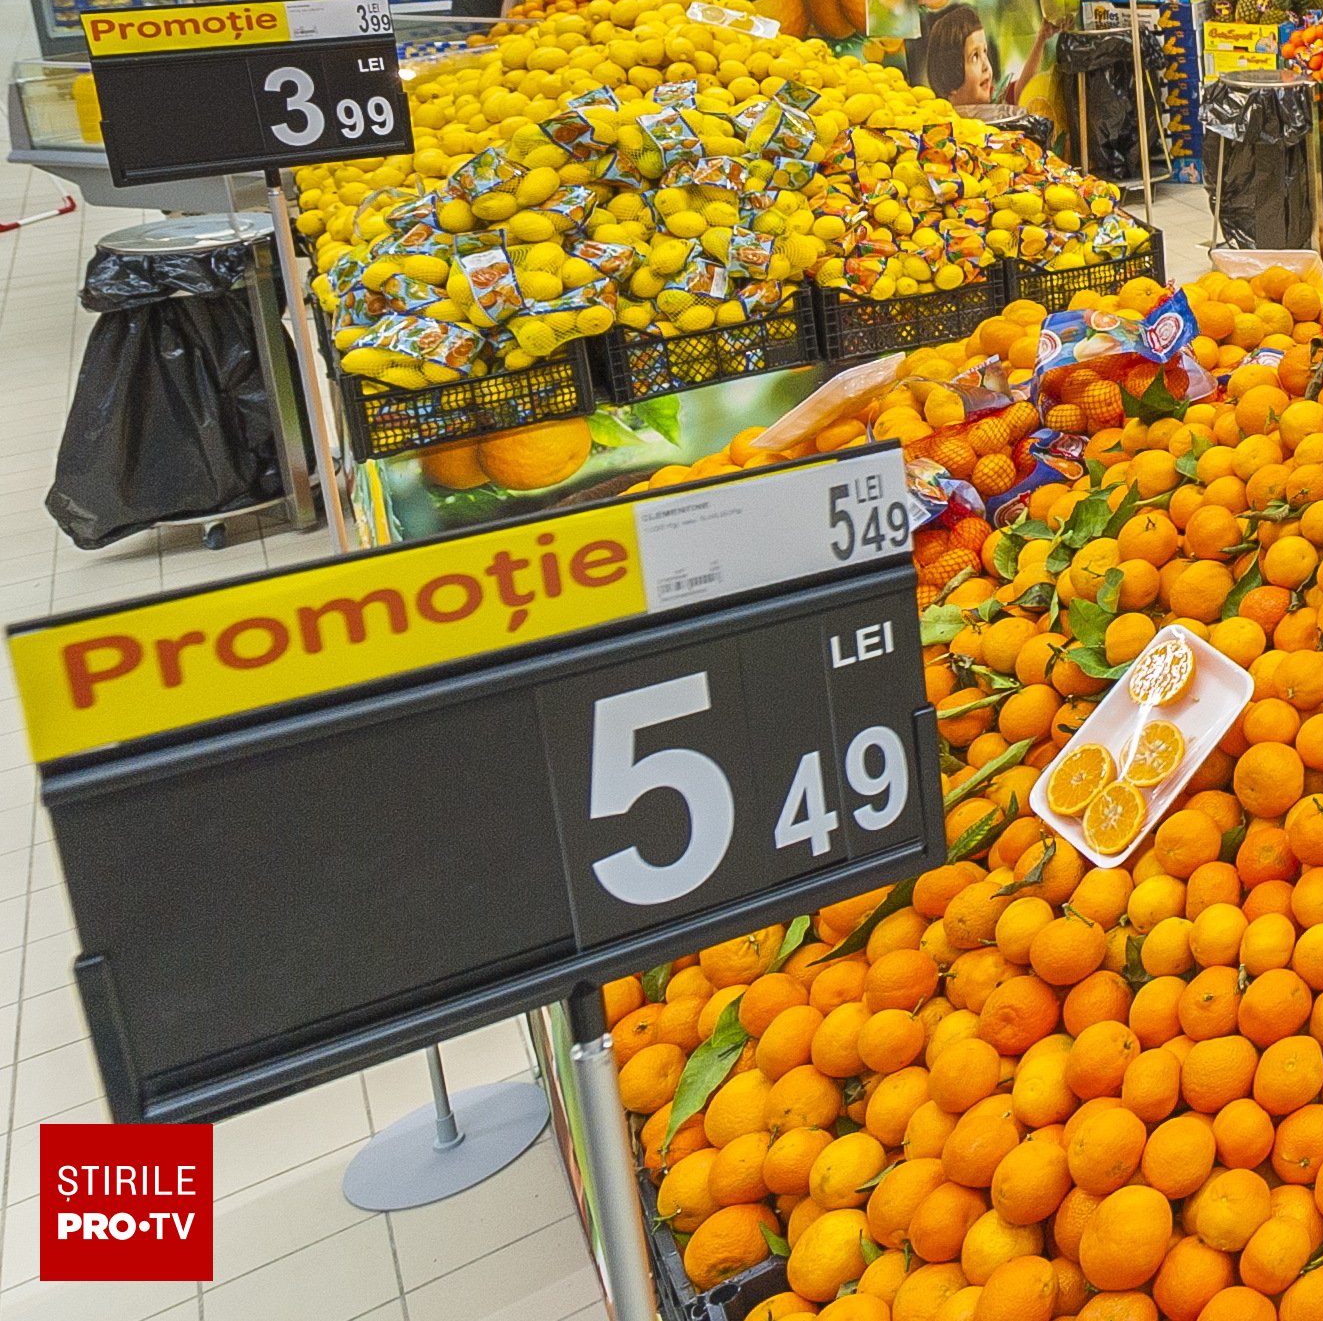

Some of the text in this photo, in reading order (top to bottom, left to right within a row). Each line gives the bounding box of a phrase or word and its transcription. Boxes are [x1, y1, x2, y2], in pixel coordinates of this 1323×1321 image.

[90, 8, 277, 41] Promoție
[357, 4, 391, 33] 3 99
[367, 3, 380, 14] LEI
[357, 57, 385, 72] LEI
[264, 66, 394, 146] 3 99
[854, 473, 883, 505] LEI
[829, 484, 910, 561] 5 49
[61, 531, 630, 709] Promoție
[830, 620, 894, 669] LEI
[588, 670, 909, 905] 5 49
